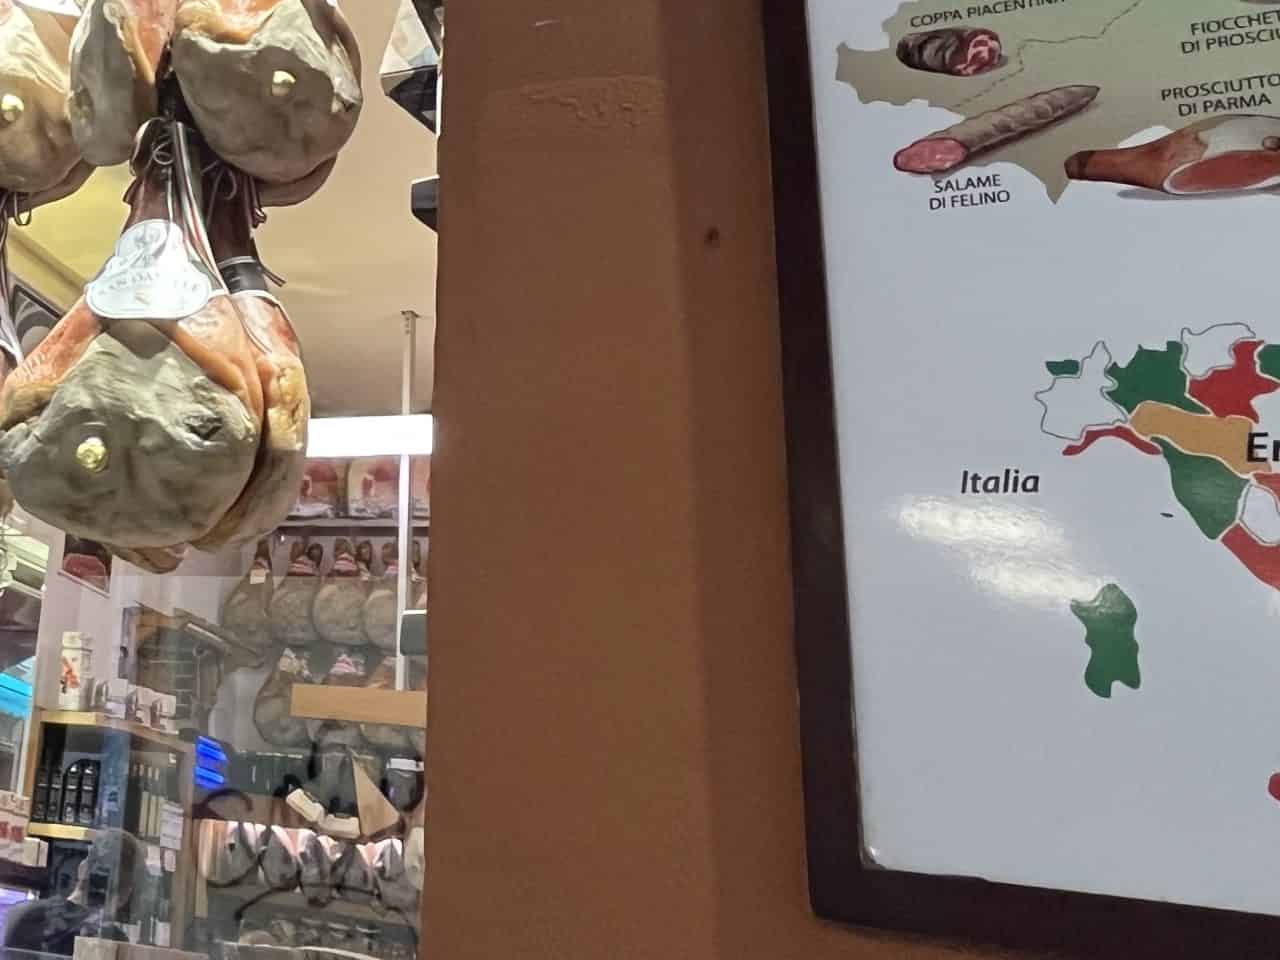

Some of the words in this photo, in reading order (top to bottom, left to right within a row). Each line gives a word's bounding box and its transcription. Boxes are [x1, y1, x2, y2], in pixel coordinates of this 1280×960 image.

[910, 9, 963, 28] COPPA
[1180, 40, 1201, 54] DI
[1161, 73, 1280, 101] PROSCIUTTO
[1177, 102, 1198, 117] DI
[1202, 92, 1272, 114] PARMA
[933, 173, 1002, 194] SALAME
[928, 196, 947, 210] DI
[950, 189, 1011, 208] FELINO
[960, 467, 1041, 495] Italia
